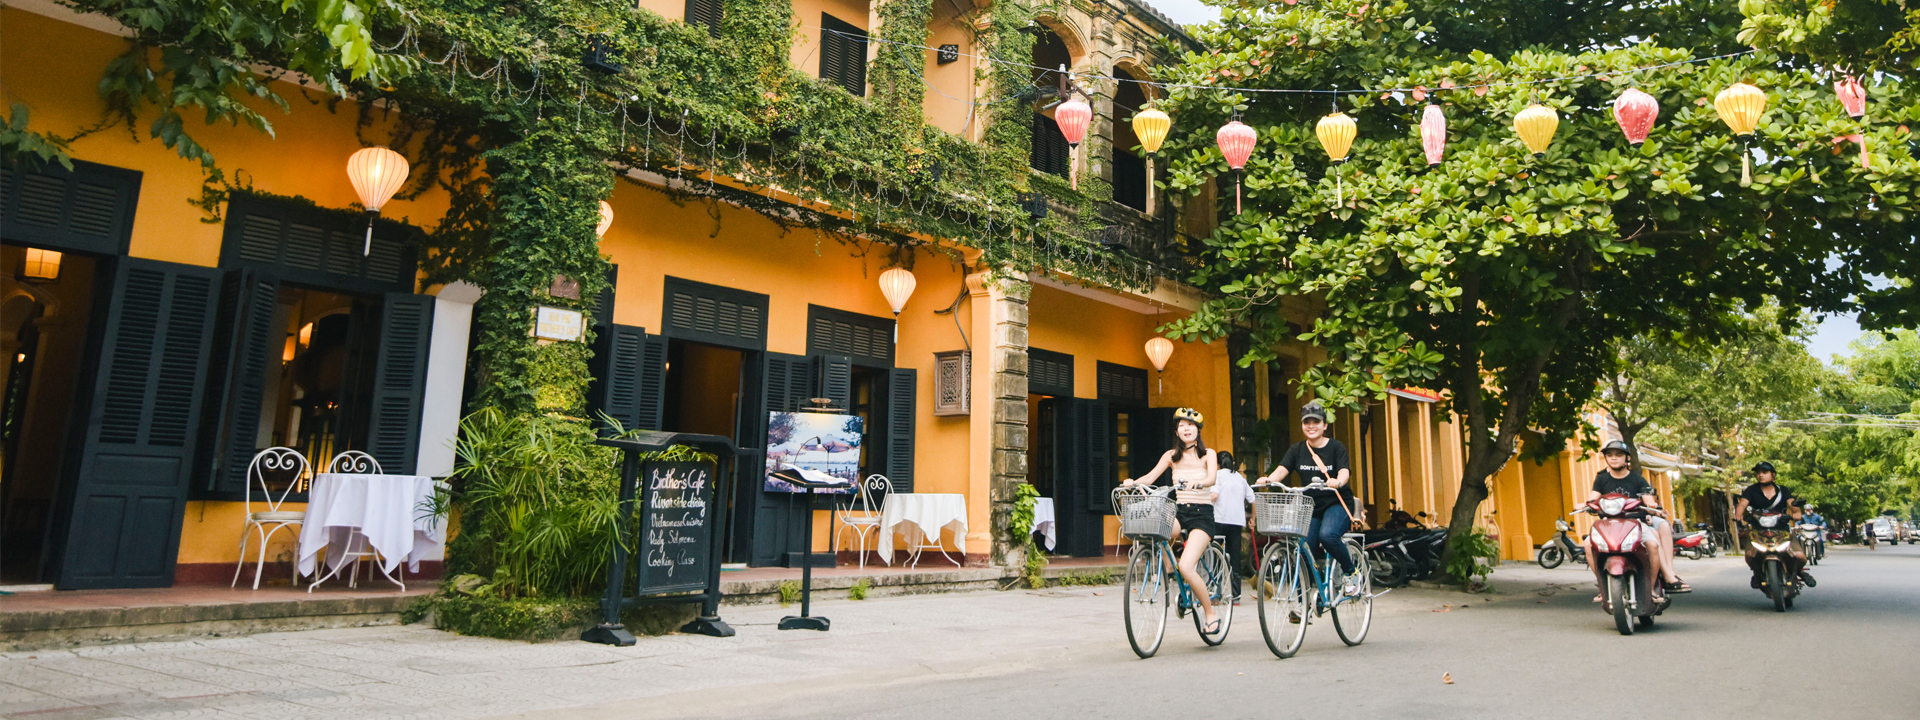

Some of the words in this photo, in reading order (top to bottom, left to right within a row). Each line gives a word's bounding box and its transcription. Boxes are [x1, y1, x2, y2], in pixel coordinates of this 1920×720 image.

[650, 467, 687, 490] Brother's
[687, 468, 706, 496] Café
[687, 491, 706, 518] dining
[651, 512, 683, 528] Vietnamese
[682, 511, 703, 528] Cuisine
[648, 529, 665, 554] Daily
[647, 549, 675, 578] Cooking
